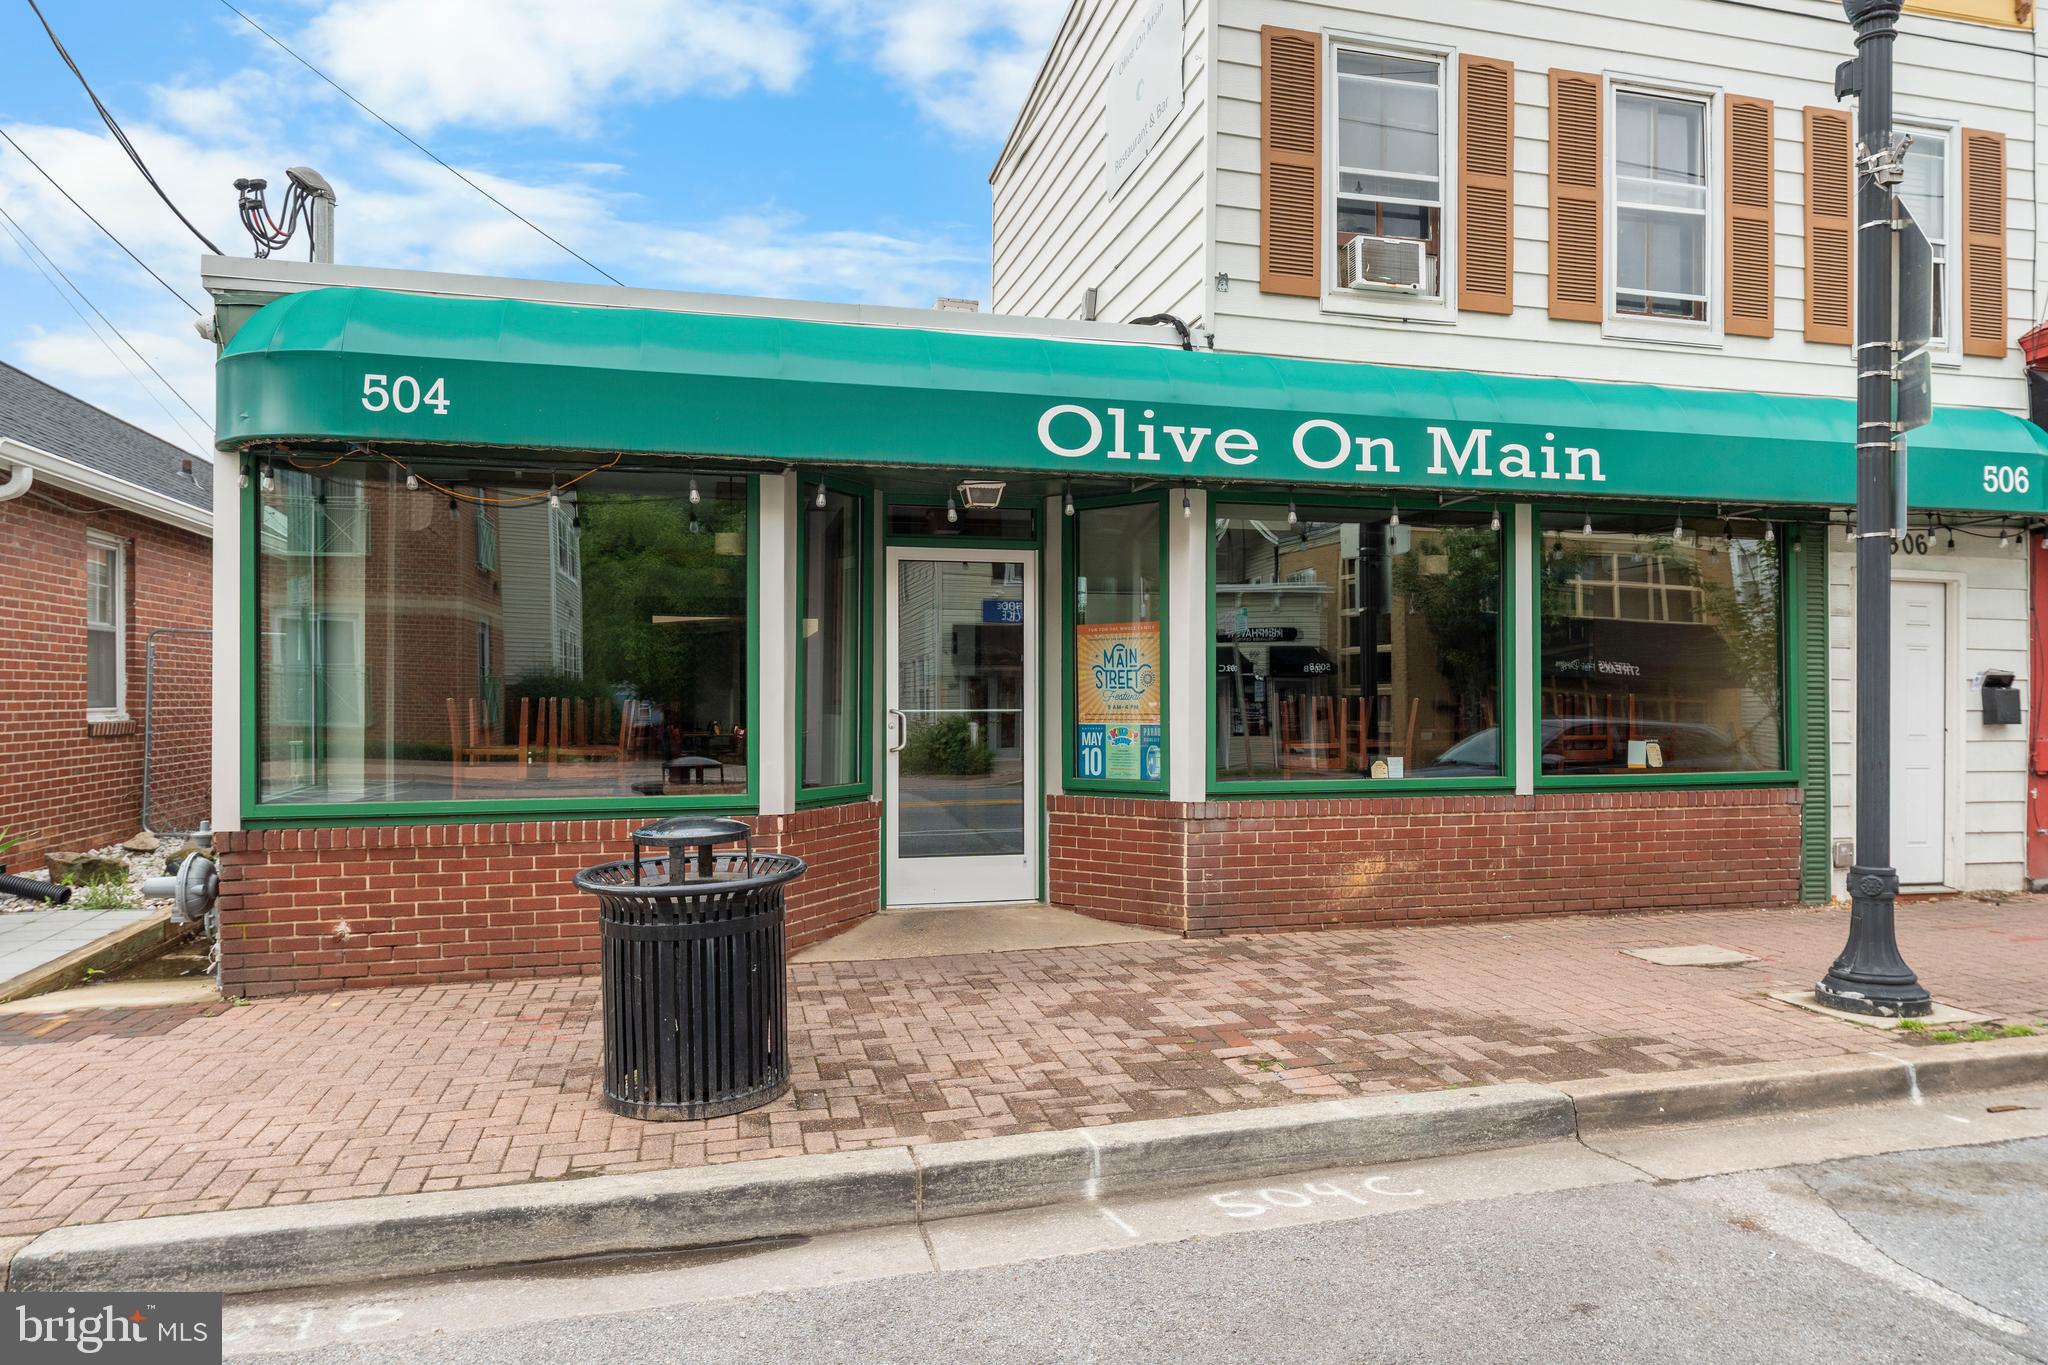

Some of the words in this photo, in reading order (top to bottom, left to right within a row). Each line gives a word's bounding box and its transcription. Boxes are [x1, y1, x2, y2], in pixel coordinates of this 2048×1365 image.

[1136, 31, 1146, 51] On
[1114, 125, 1149, 174] Restaurant
[1147, 113, 1156, 129] &
[1156, 96, 1169, 119] Bar
[361, 373, 451, 416] 504
[1037, 404, 1260, 466] Olive
[1292, 418, 1401, 474] On
[1426, 426, 1607, 482] Main
[1983, 465, 2030, 494] 506
[1103, 644, 1138, 669] MAIN
[1094, 665, 1148, 692] STREET
[1103, 689, 1142, 702] Festival
[1081, 731, 1103, 746] MAY
[1081, 747, 1103, 777] 10
